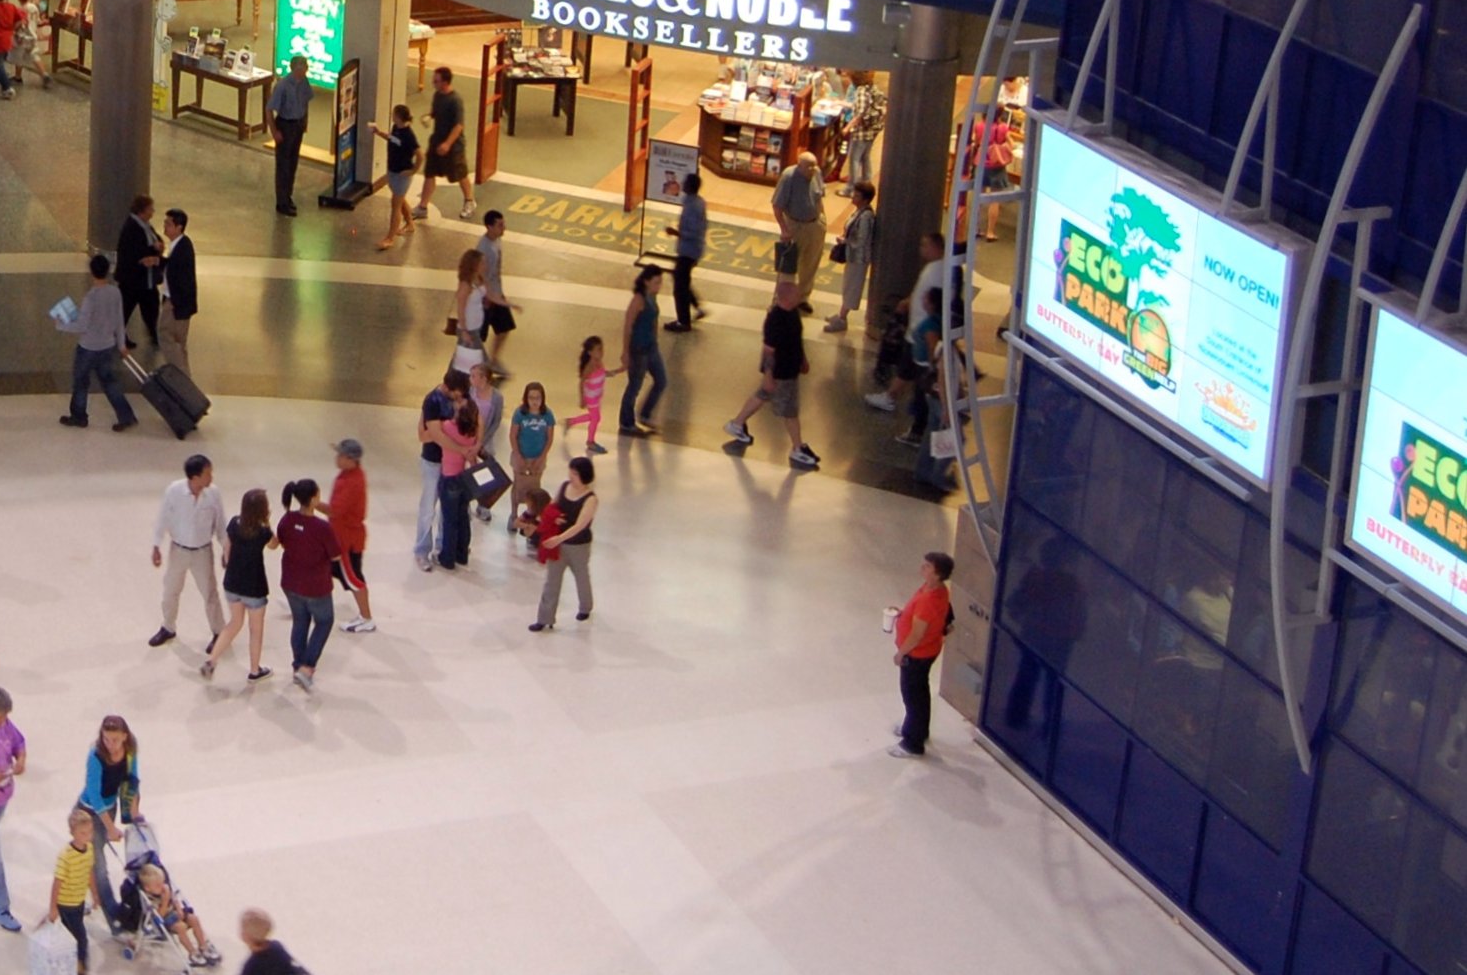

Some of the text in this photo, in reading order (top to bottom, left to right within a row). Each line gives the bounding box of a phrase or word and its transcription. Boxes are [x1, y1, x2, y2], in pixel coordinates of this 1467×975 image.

[1068, 232, 1126, 294] ECO
[1203, 254, 1280, 310] NOW OPEN!
[1036, 303, 1095, 348] BUTTERFLY
[1065, 272, 1129, 335] PARK
[1366, 517, 1446, 576] BUTTERFLY
